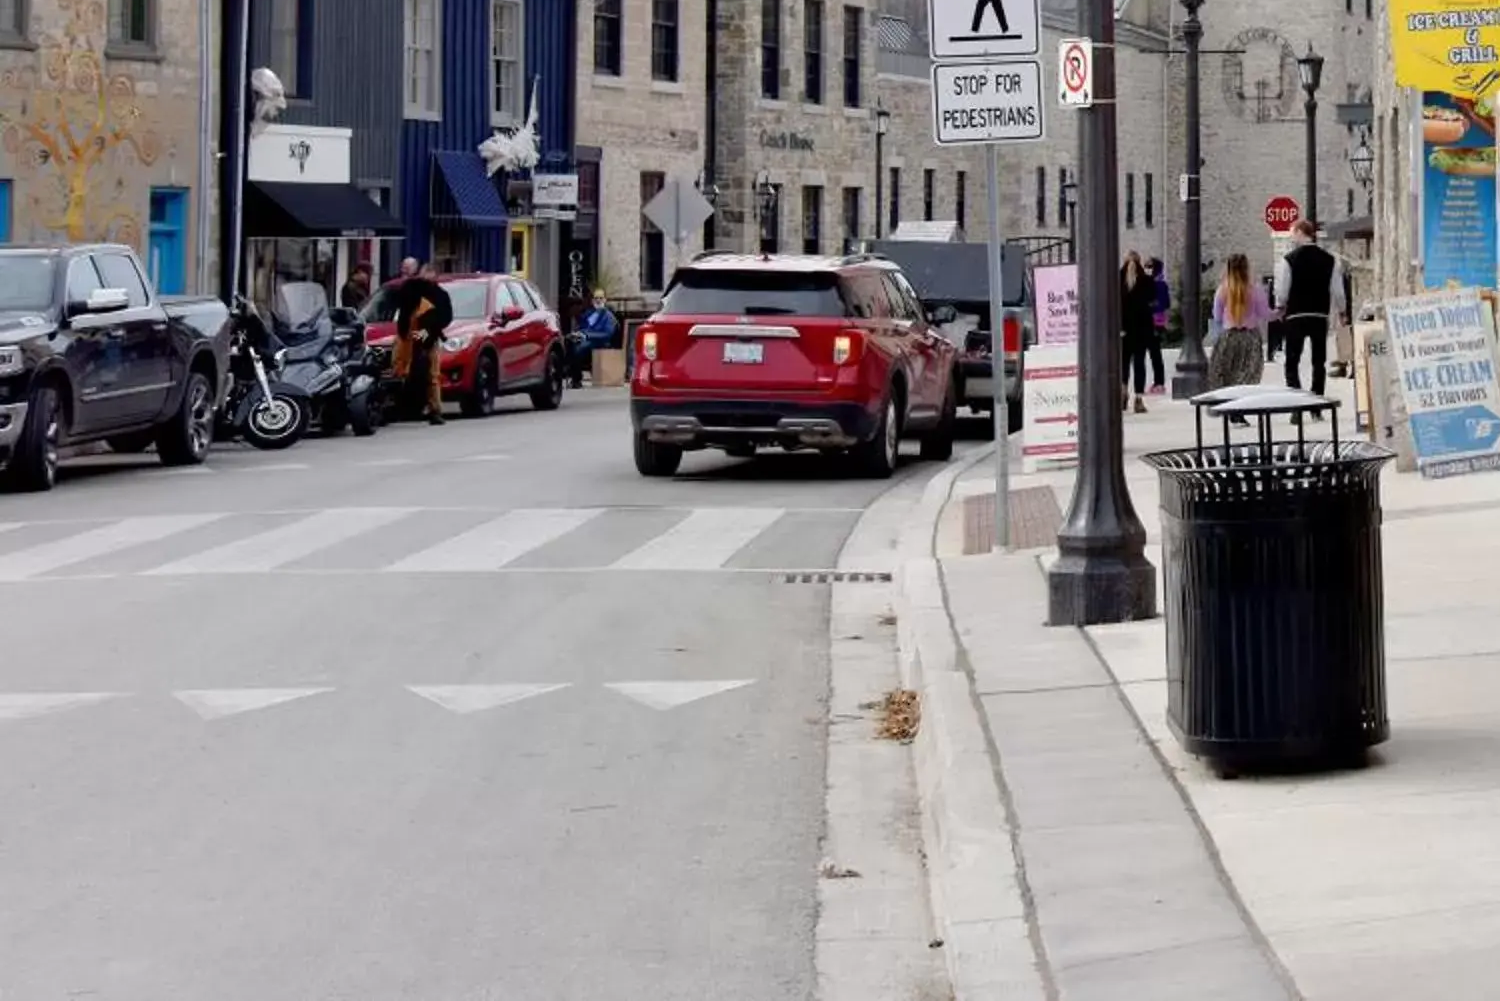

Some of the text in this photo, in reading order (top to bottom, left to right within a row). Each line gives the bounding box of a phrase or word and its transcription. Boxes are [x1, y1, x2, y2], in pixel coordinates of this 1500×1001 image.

[1407, 12, 1436, 31] ICE
[1439, 10, 1497, 27] CREAM
[1464, 27, 1480, 46] &
[1448, 46, 1499, 65] GRILL
[953, 73, 1022, 96] STOP FOR
[943, 106, 1035, 129] PEDESTRIANS
[1267, 207, 1298, 221] STOP
[568, 250, 584, 298] OPEN
[1391, 302, 1483, 338] Frozen Yogurt
[1404, 359, 1492, 391] ICE CREAM
